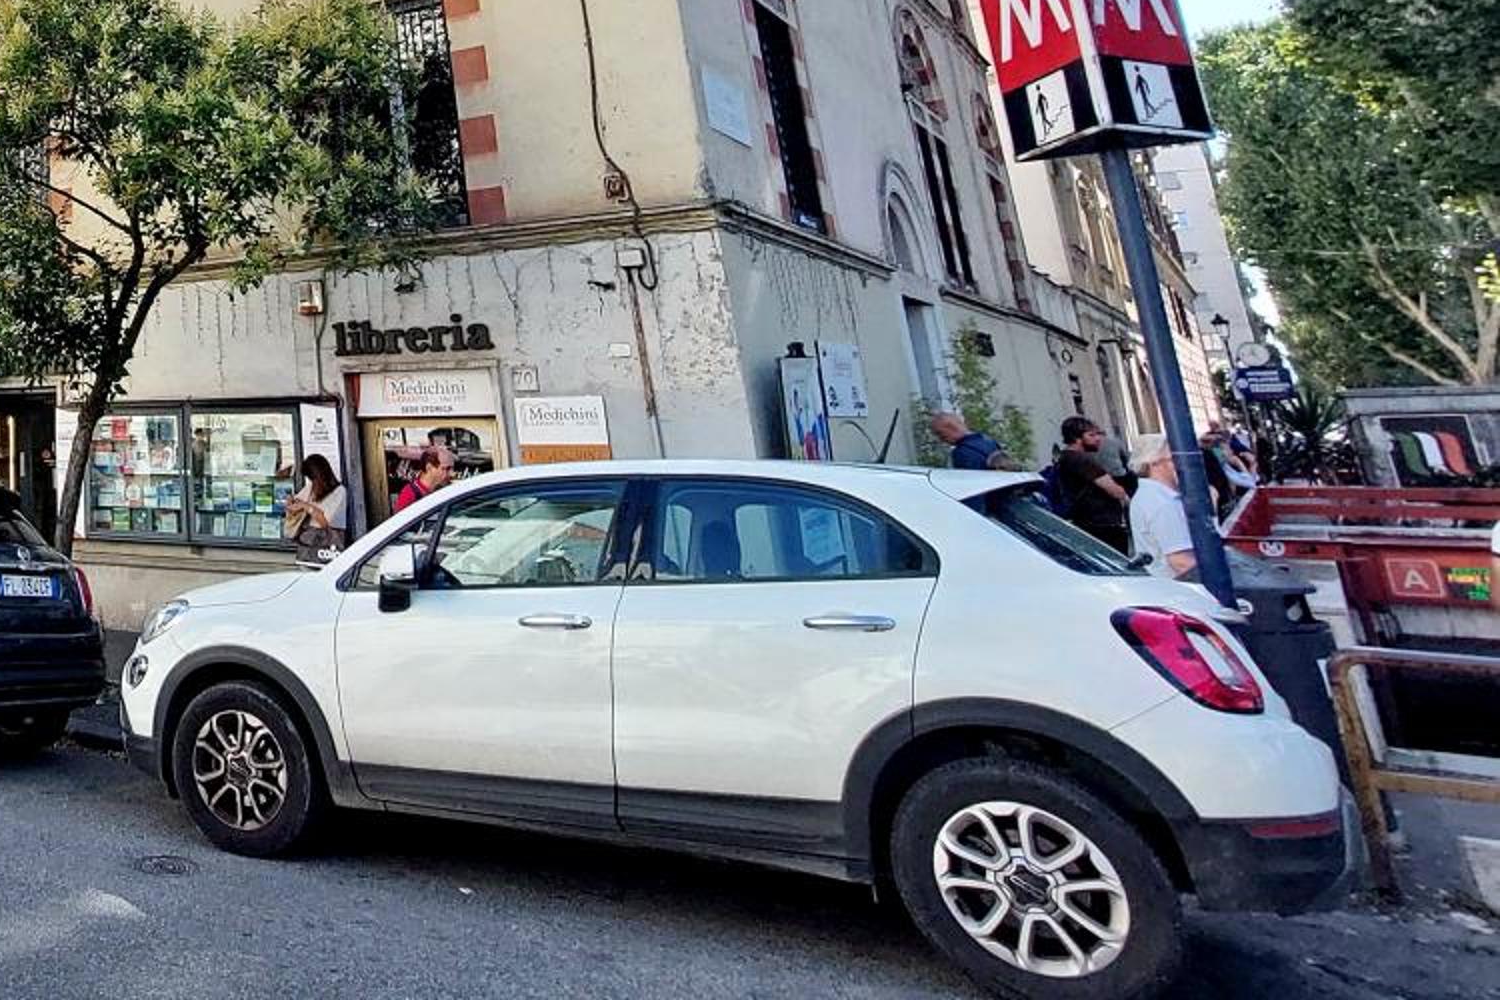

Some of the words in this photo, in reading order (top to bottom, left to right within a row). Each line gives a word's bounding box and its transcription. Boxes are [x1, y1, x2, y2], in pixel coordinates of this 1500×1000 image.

[332, 313, 496, 357] libreria
[512, 371, 533, 386] 70
[389, 379, 466, 396] Medichini
[528, 406, 600, 422] Medichini
[1404, 567, 1431, 590] A
